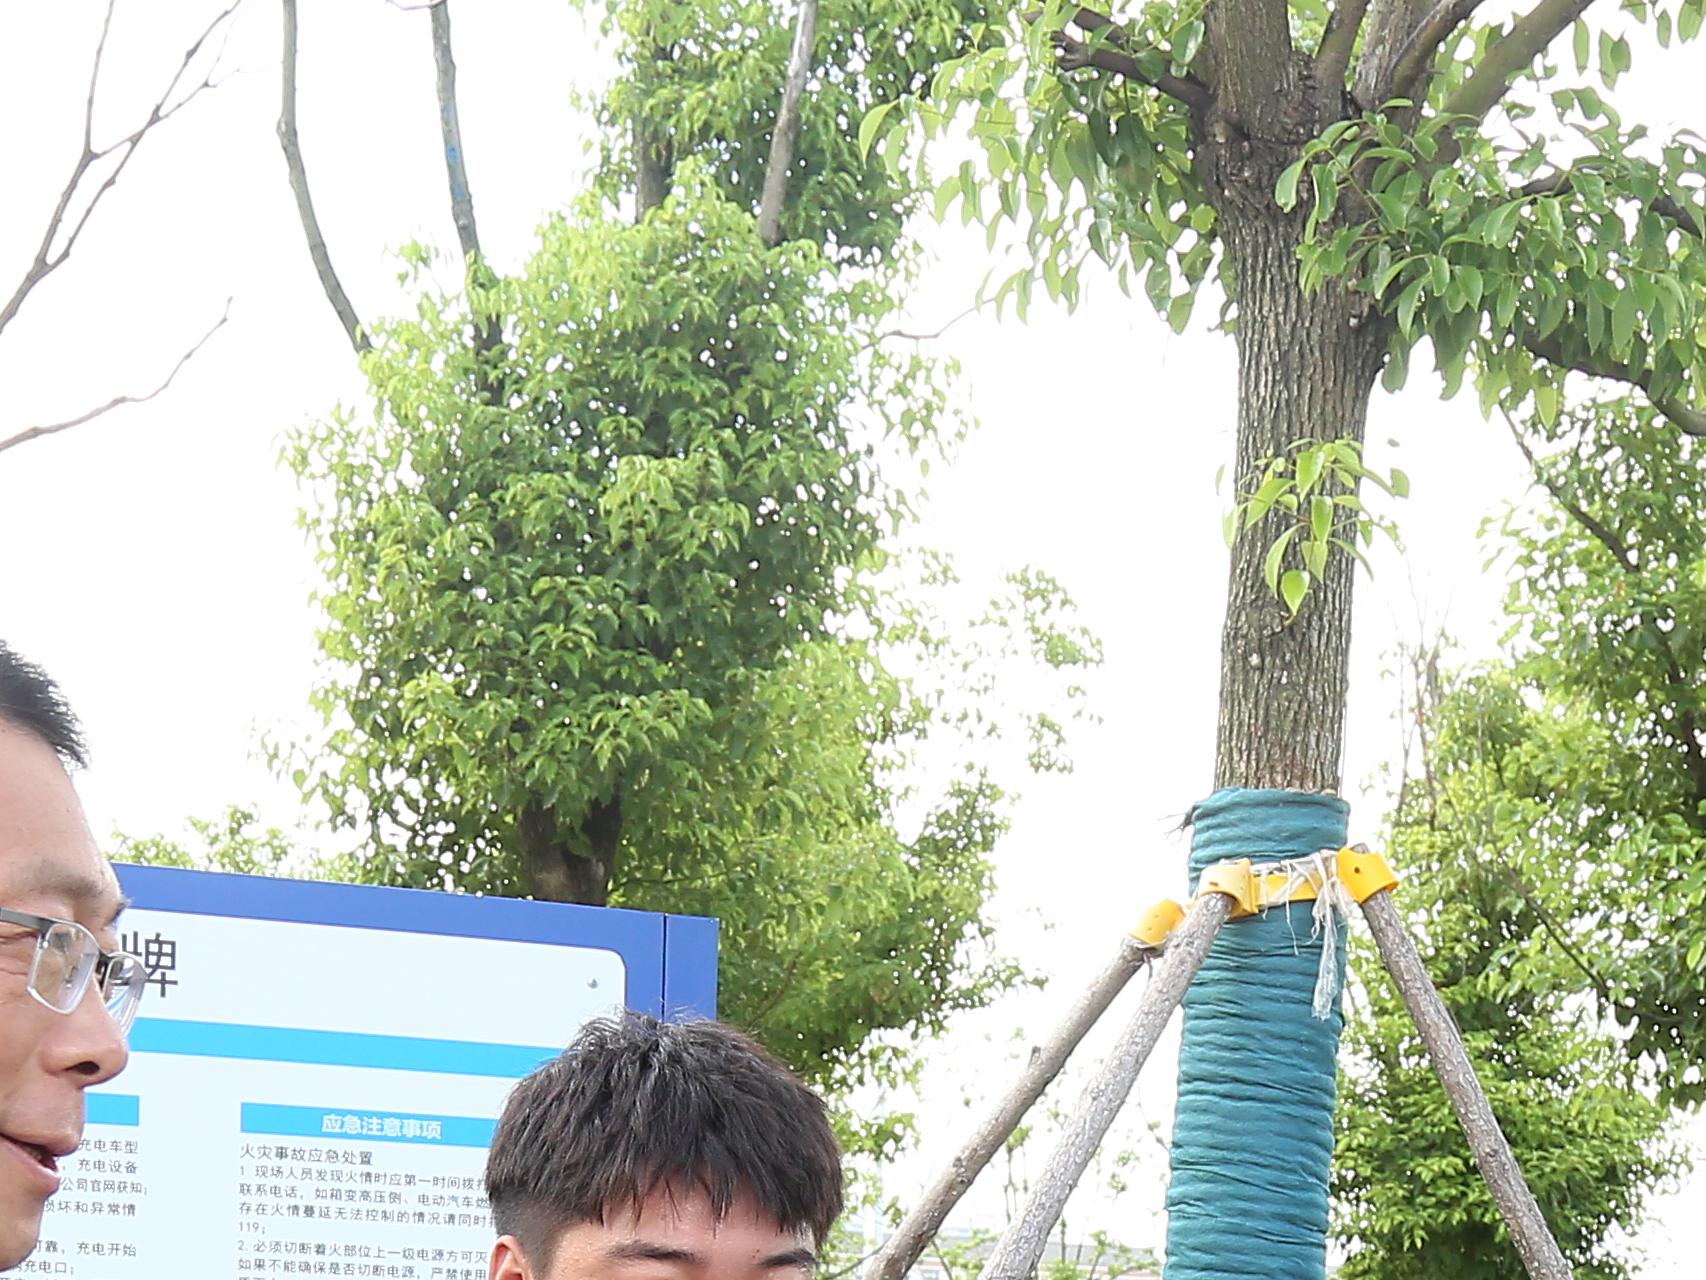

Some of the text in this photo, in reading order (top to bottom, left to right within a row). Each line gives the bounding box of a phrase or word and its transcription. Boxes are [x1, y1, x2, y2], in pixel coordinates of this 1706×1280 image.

[321, 1113, 442, 1141] 应急注意事项
[240, 1144, 374, 1166] 火灾事故应急处置
